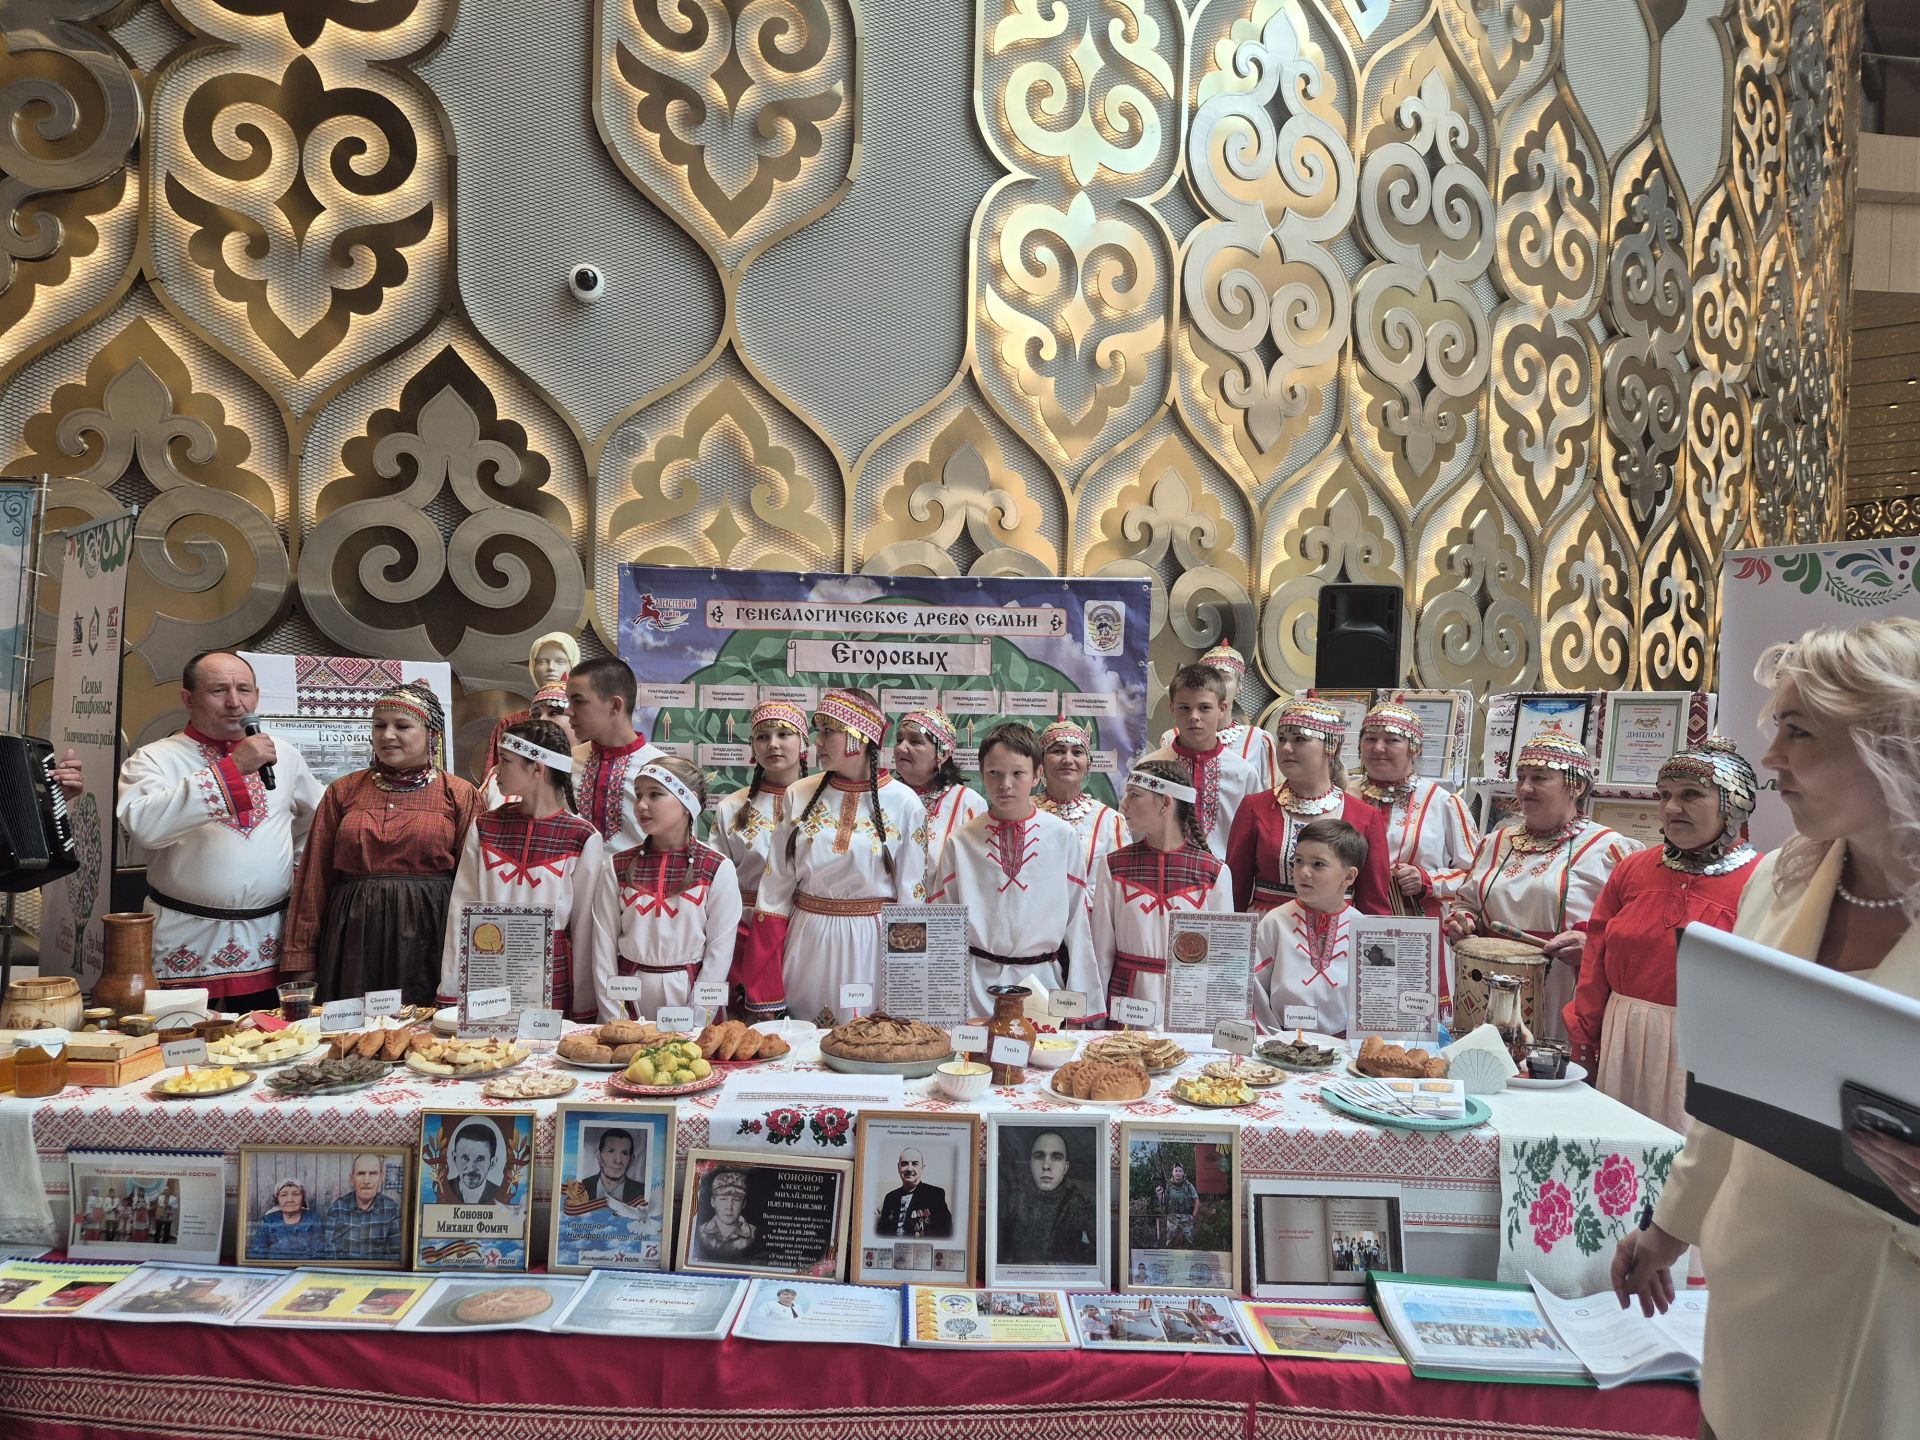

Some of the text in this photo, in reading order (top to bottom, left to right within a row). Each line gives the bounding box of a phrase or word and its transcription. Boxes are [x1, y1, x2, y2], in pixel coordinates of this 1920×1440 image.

[736, 607, 1037, 628] ГЕНЕАЛОГИЧЕСКОЕ ДРЕВО СЕМЬИ
[831, 642, 948, 672] Егоровых
[81, 675, 103, 695] Семья
[72, 696, 112, 719] Гарифовых
[1626, 731, 1665, 739] ДИПЛОМ
[778, 1172, 824, 1183] КОНОНОВ
[780, 1183, 821, 1192] АЛЕКСАНДР
[775, 1191, 824, 1201] МИХАЙЛОВИЧ
[453, 1207, 493, 1220] Кононов
[437, 1221, 508, 1234] Михаил Фомич
[567, 1221, 606, 1229] Степанов
[567, 1231, 601, 1240] Никифор
